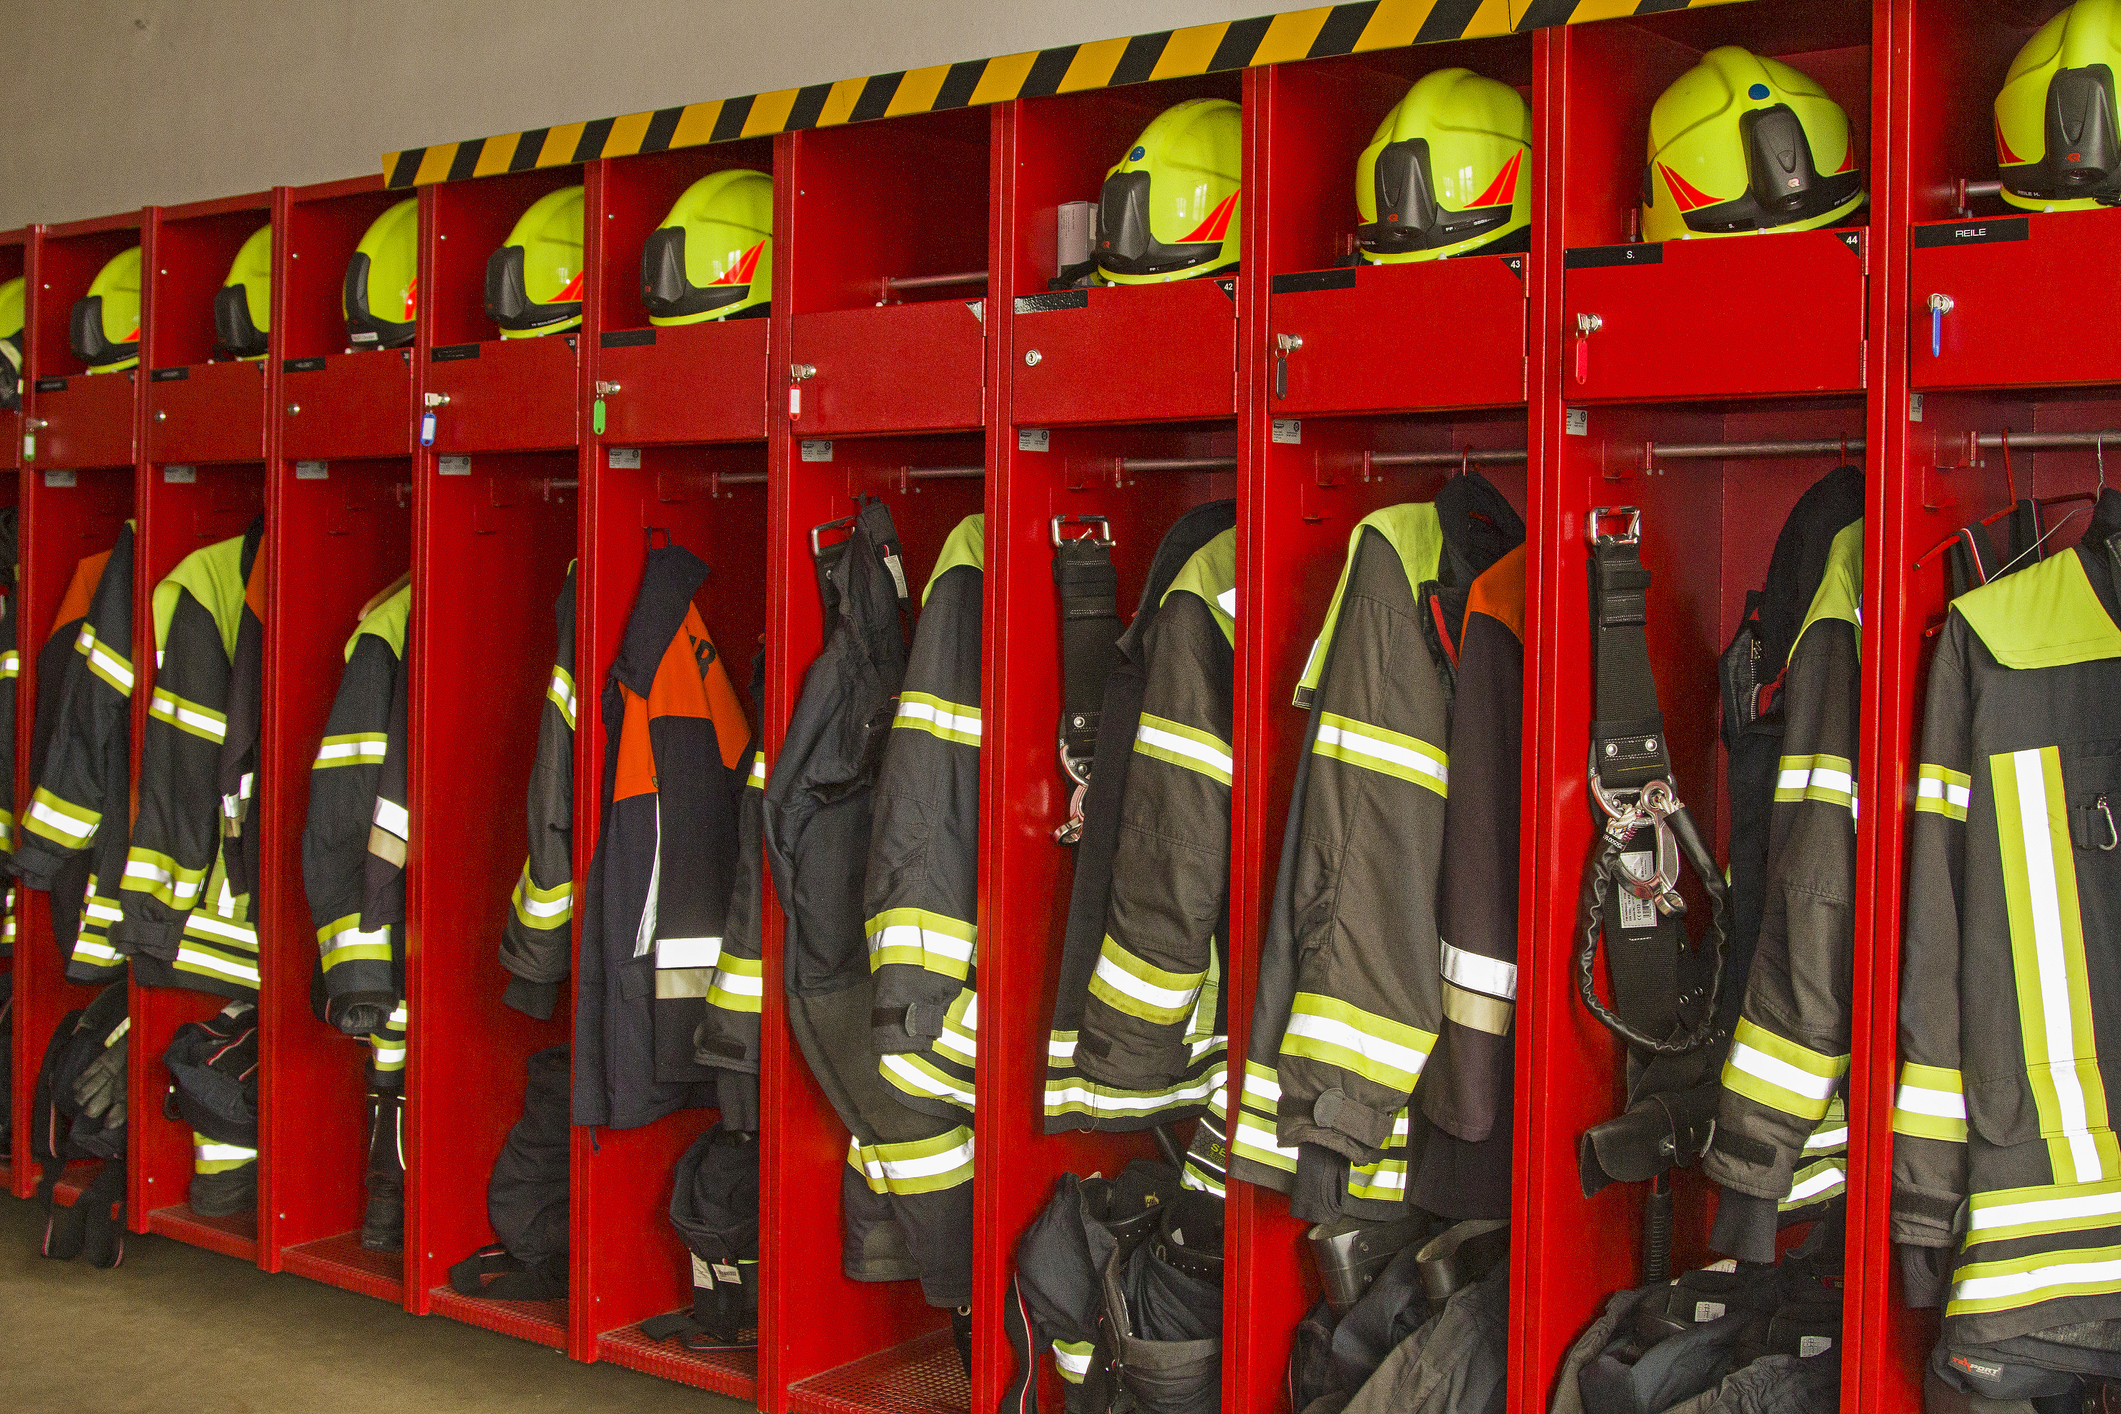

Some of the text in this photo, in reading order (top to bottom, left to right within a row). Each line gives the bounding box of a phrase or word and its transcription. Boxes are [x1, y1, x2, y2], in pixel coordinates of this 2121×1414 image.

[1955, 228, 1987, 238] REILE
[1846, 235, 1859, 245] 44
[1626, 250, 1635, 259] S.
[1510, 260, 1521, 269] 43
[1223, 282, 1233, 291] 42
